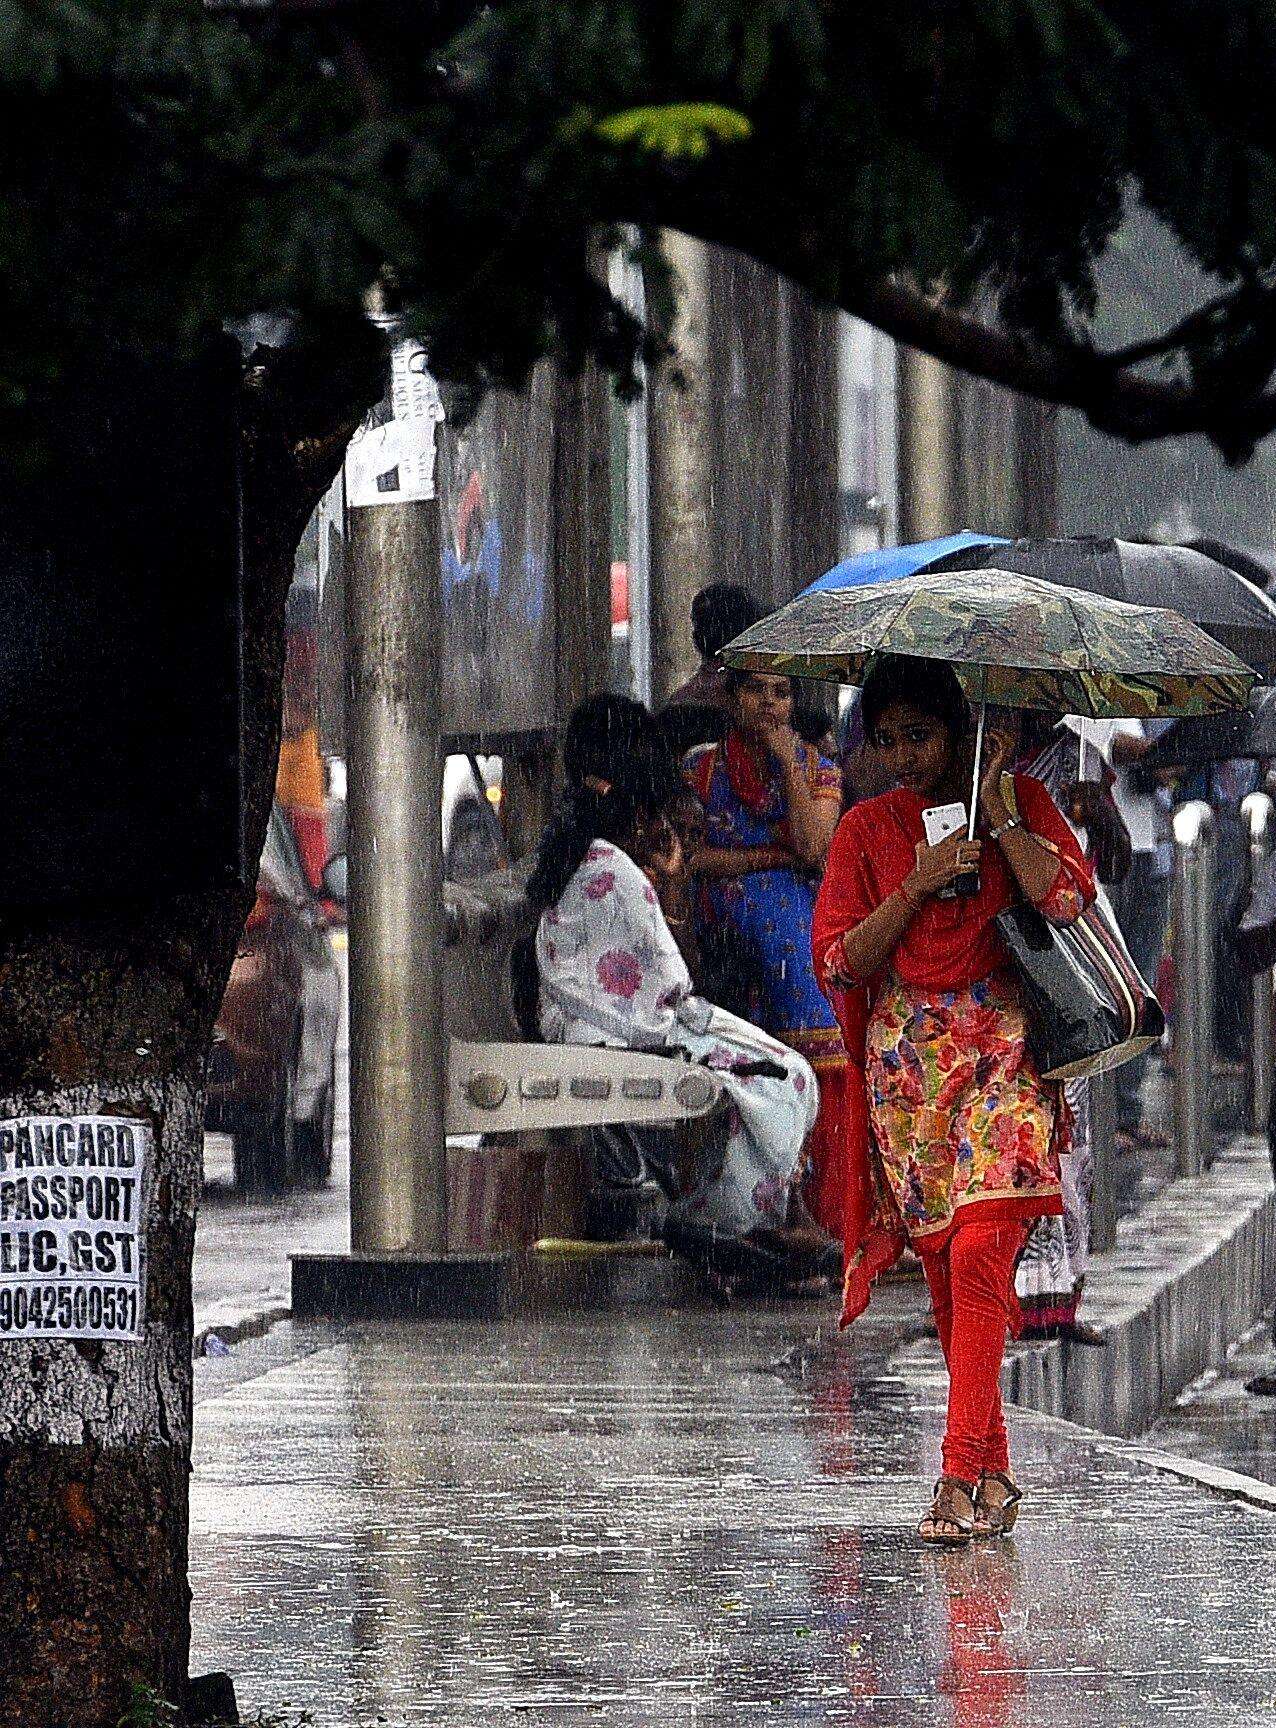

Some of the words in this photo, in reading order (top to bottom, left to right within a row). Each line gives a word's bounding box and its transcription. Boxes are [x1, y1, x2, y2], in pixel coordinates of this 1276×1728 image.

[0, 1121, 135, 1171] PANCARD
[0, 1175, 136, 1222] PASSPORT
[0, 1286, 137, 1331] 9042500531
